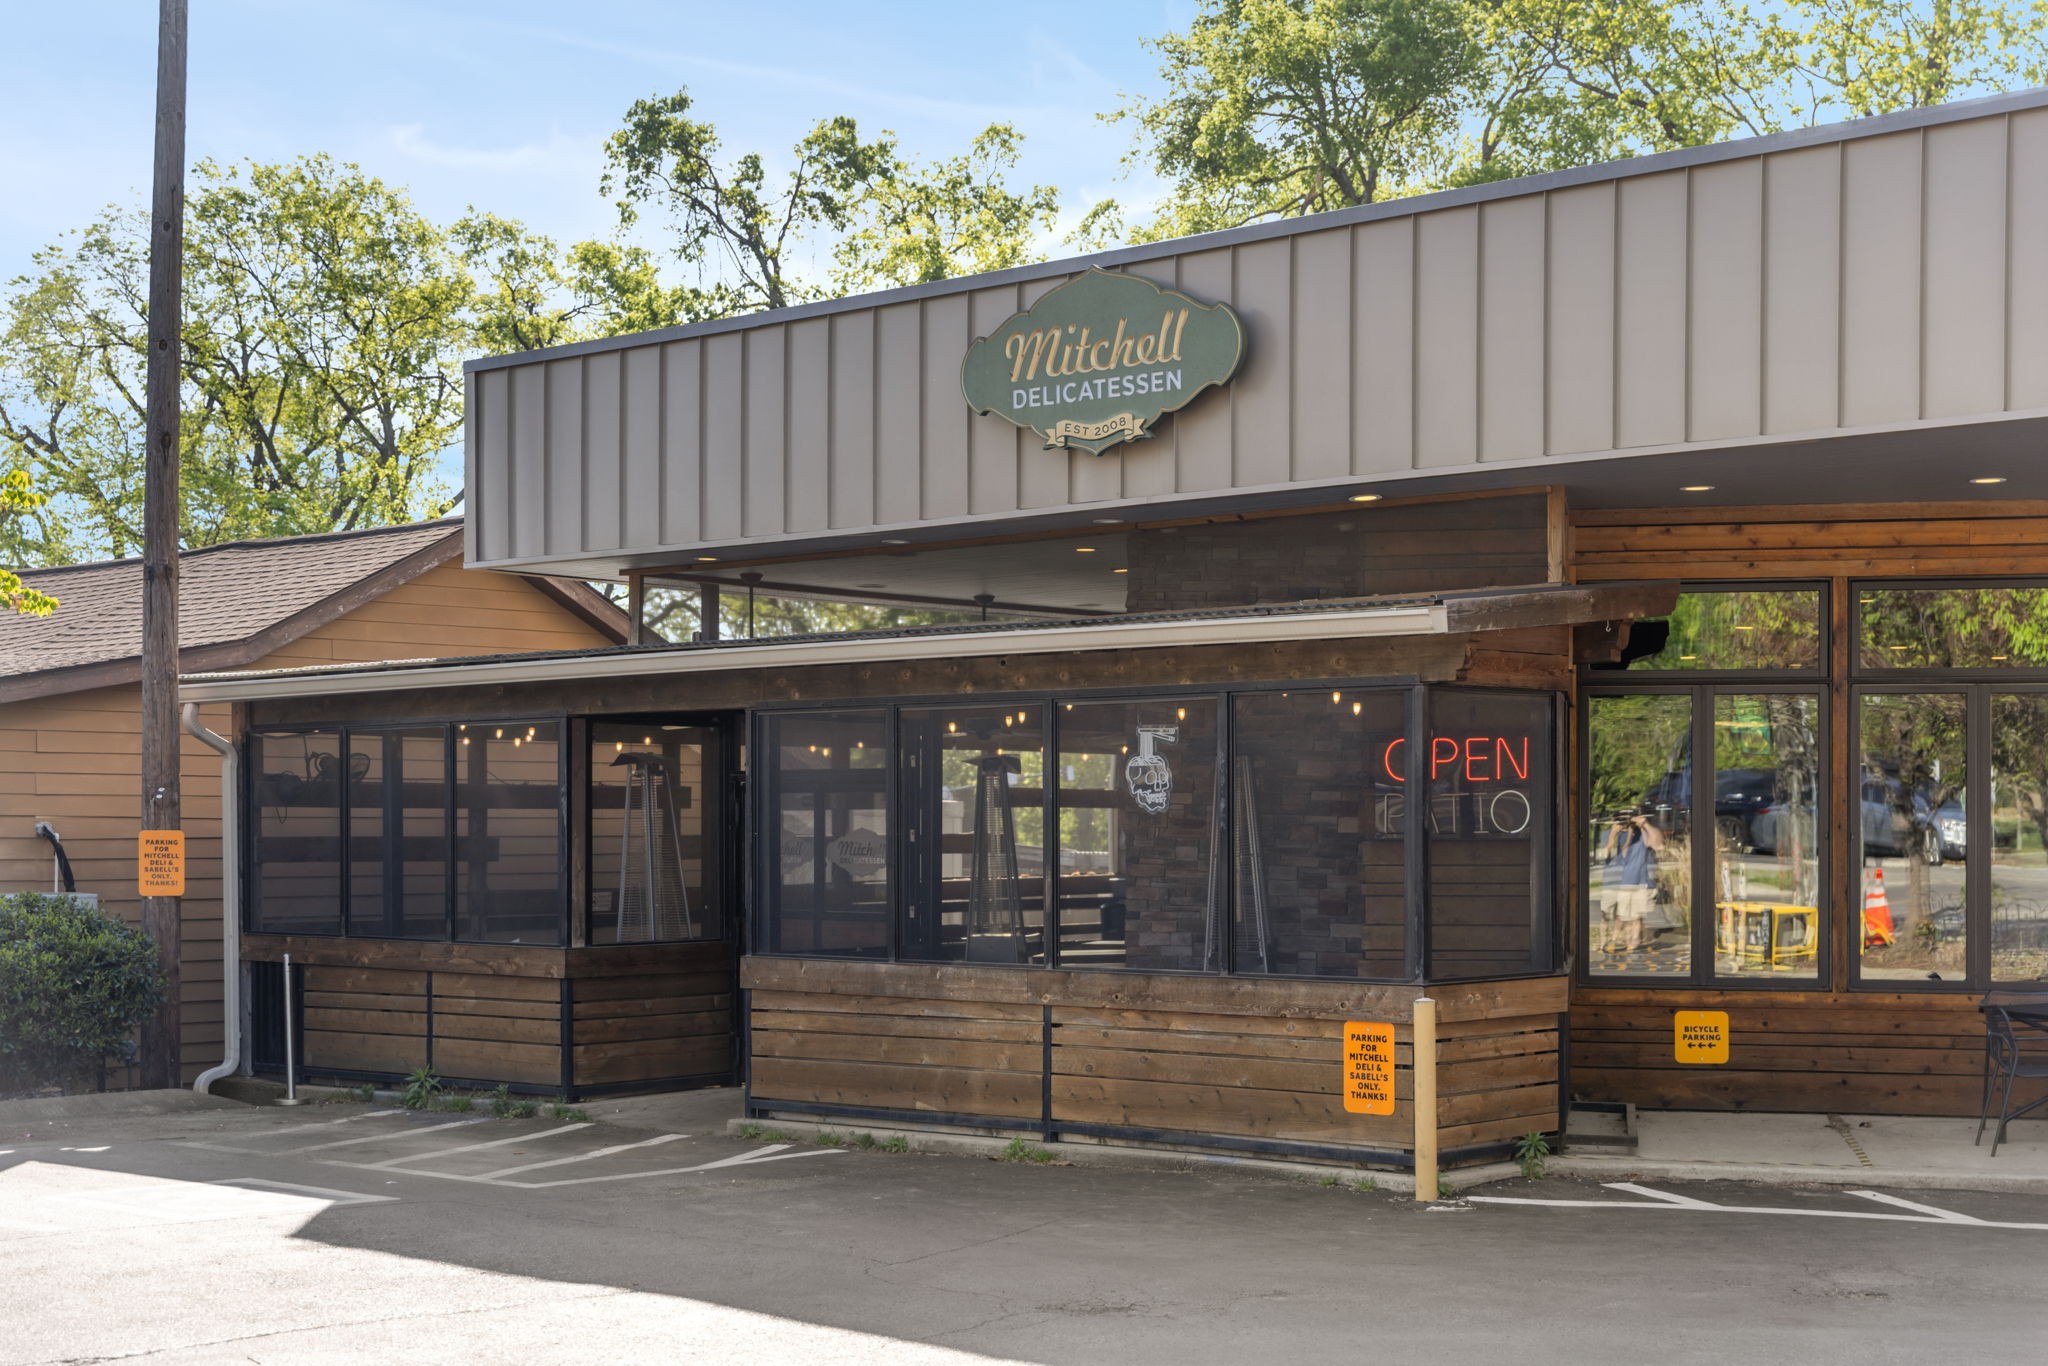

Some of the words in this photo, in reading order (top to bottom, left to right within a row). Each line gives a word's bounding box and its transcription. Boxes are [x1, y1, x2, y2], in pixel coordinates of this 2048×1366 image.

[1005, 307, 1189, 382] Mitchell
[1013, 369, 1182, 409] DELICATESSEN
[1065, 423, 1089, 436] EST
[1095, 417, 1126, 436] 2008
[1384, 789, 1530, 834] PTIO
[1351, 1034, 1387, 1043] PARKING
[1360, 1044, 1377, 1052] FOR
[1350, 1053, 1388, 1062] MITCHELL
[1356, 1063, 1374, 1071] DELI
[1350, 1072, 1388, 1082] SABELL'S
[1358, 1082, 1380, 1091] ONLY.
[1351, 1091, 1388, 1101] THANKS!
